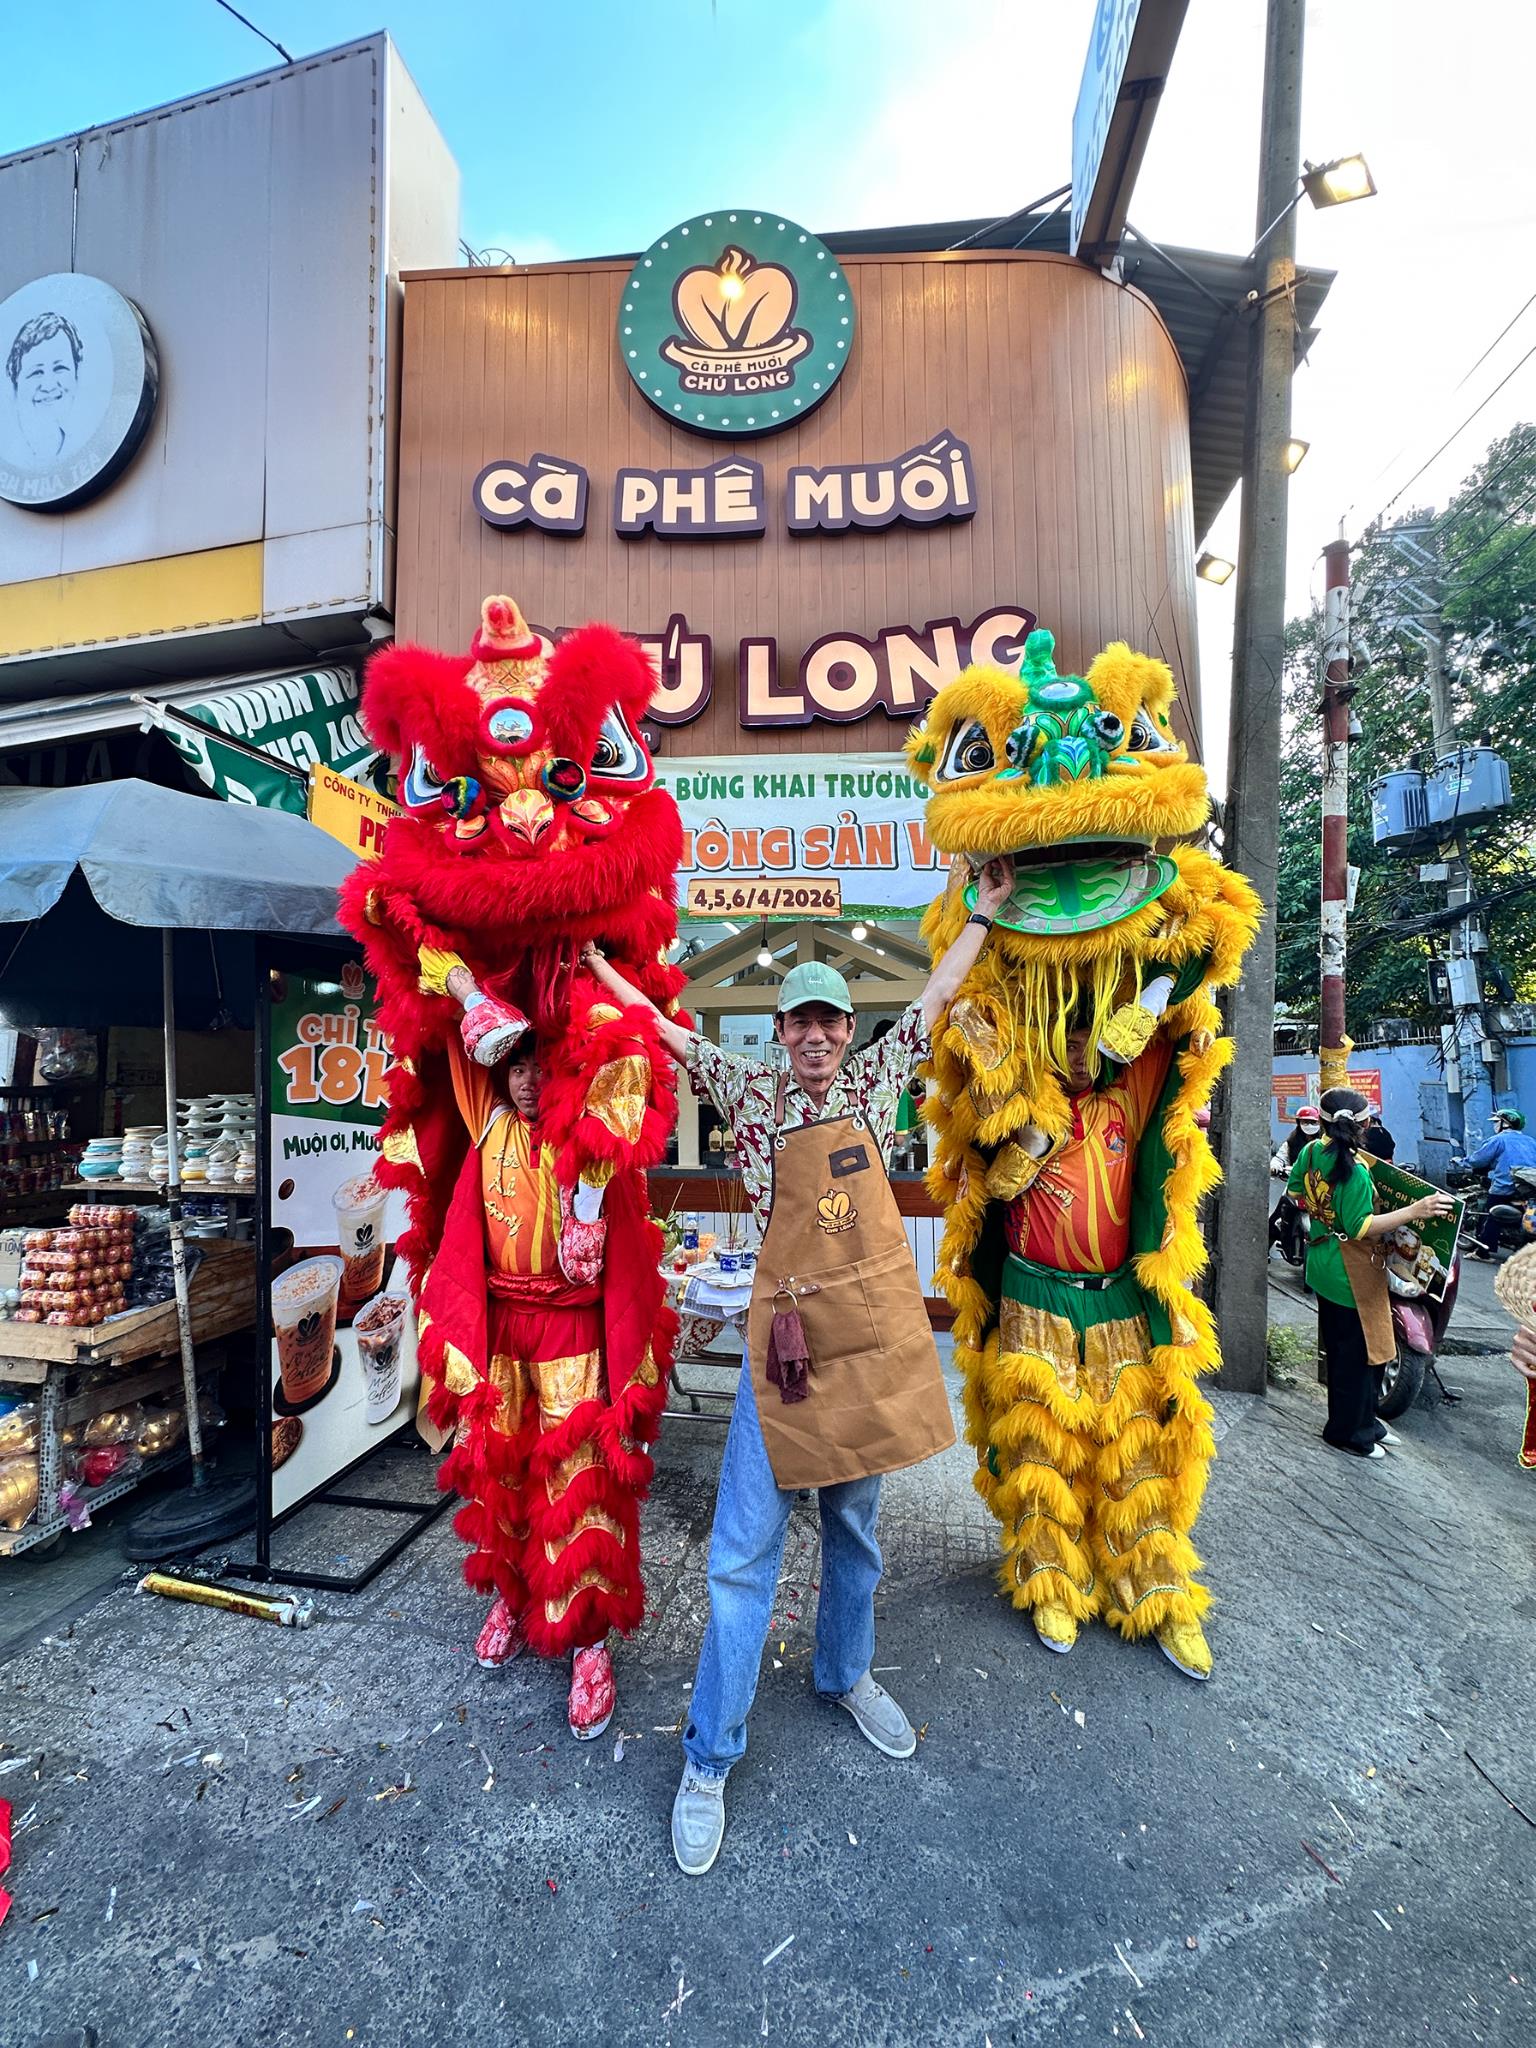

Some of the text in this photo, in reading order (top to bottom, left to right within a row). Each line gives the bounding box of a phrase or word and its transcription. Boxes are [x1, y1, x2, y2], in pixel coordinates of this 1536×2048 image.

[685, 371, 789, 391] CHÚ LONG
[715, 362, 742, 372] PHÊ
[622, 463, 757, 523] PHÊ
[748, 613, 1027, 716] LONG
[323, 775, 356, 801] CÔNG
[358, 792, 371, 807] TY
[676, 769, 929, 800] BỪNG KHAI TRƯƠNG
[803, 810, 897, 871] SẢN
[694, 888, 836, 911] 4,5,6/4/2026
[299, 1006, 359, 1045] CHỈ
